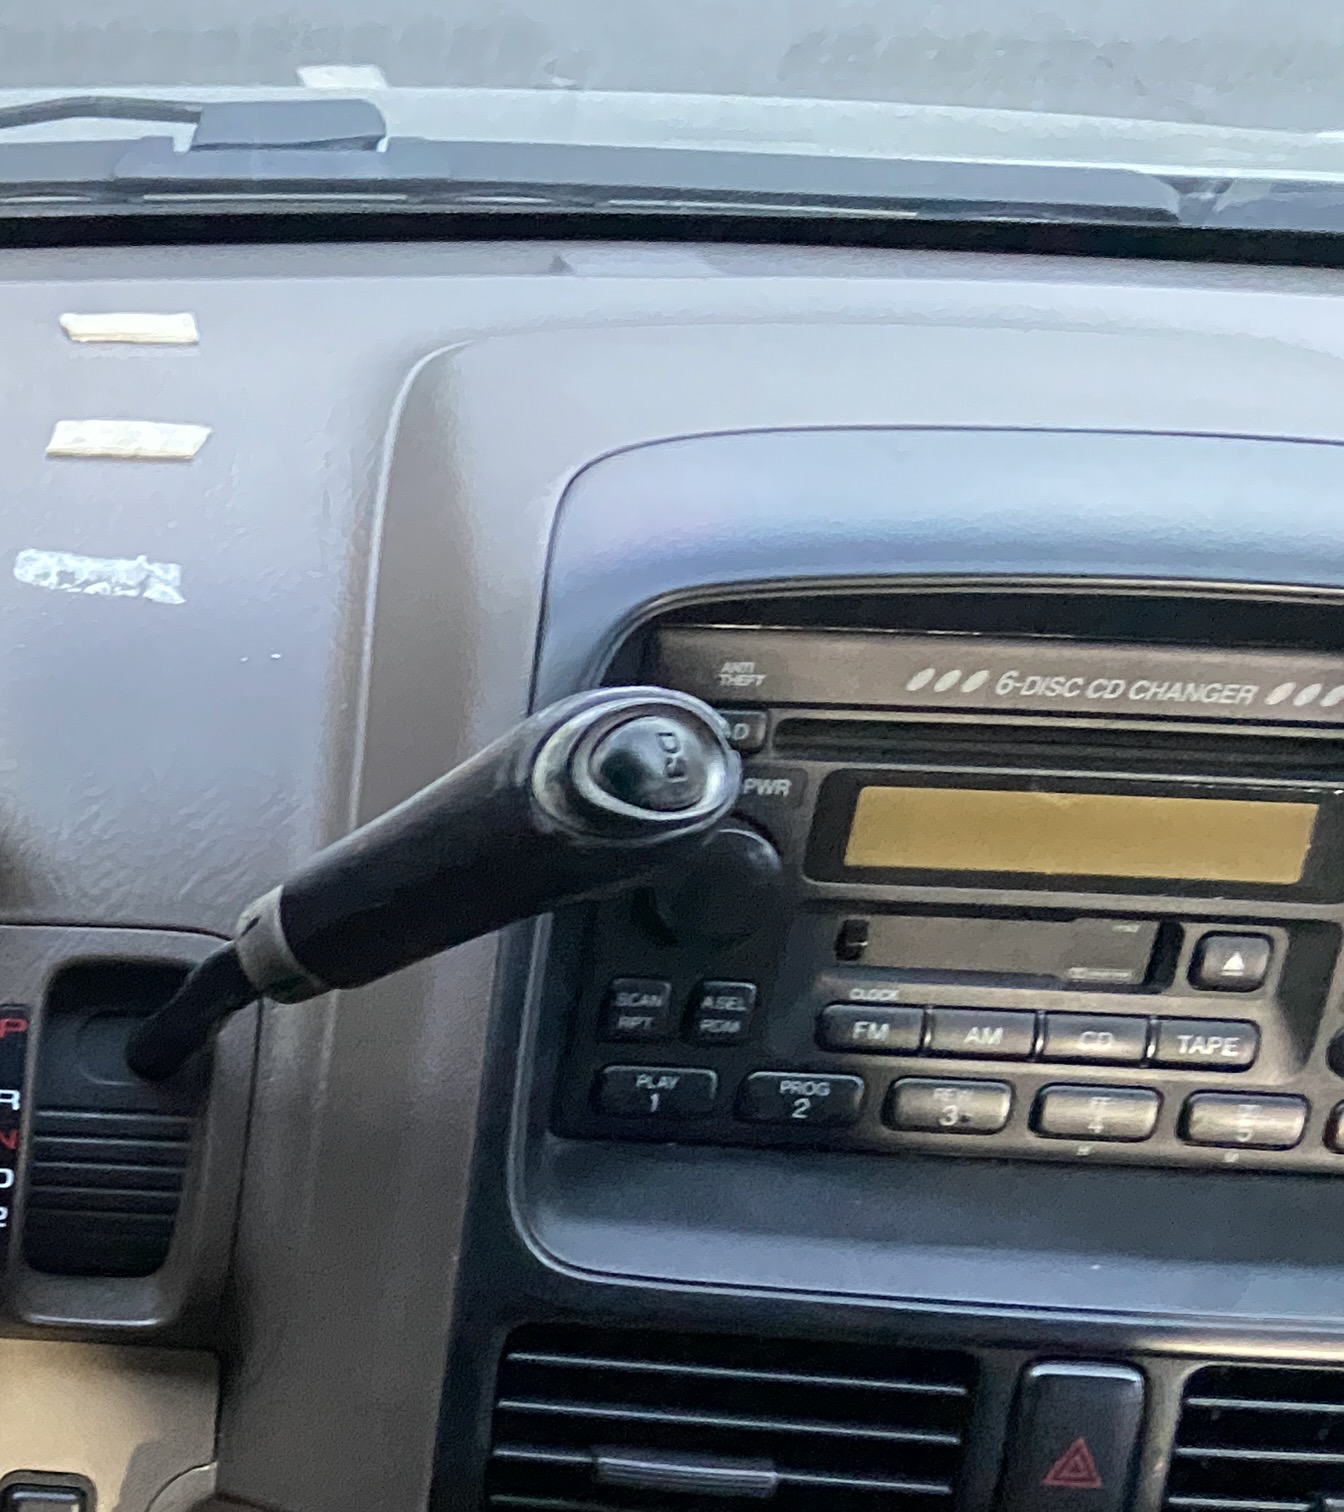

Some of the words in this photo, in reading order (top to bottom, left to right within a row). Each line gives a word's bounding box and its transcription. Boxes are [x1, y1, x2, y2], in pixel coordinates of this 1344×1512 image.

[721, 661, 755, 674] ANTI
[719, 674, 767, 687] THEFT
[995, 670, 1084, 698] 6-DISC
[1086, 678, 1126, 699] CD
[1128, 679, 1259, 705] CHANGER
[743, 777, 792, 797] PWR
[850, 988, 901, 1001] CLOCK
[851, 1021, 891, 1041] FM
[964, 1026, 1004, 1046] AM
[1078, 1031, 1114, 1050] CD
[1177, 1034, 1240, 1057] TAPE
[635, 1073, 681, 1090] PLAY
[779, 1080, 831, 1097] PROG
[649, 1092, 660, 1113] 1
[791, 1098, 811, 1119] 2
[938, 1104, 960, 1127] 3
